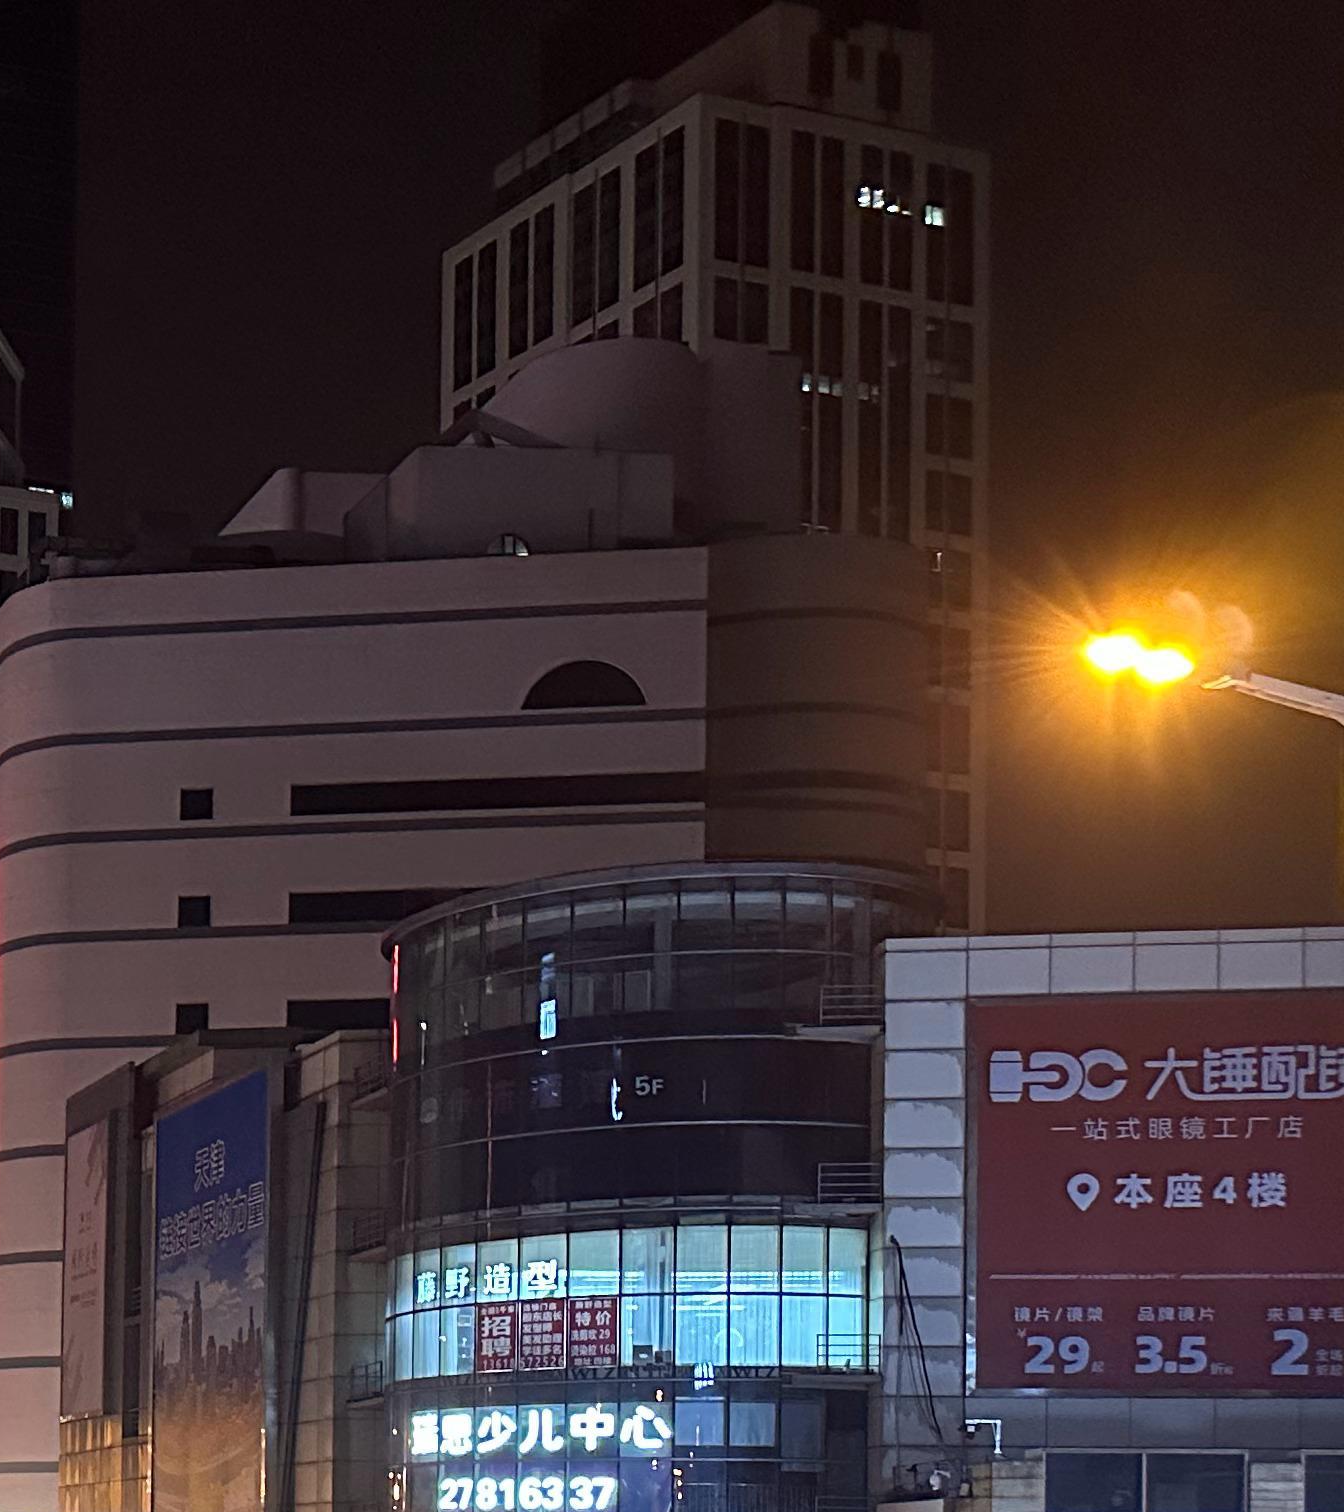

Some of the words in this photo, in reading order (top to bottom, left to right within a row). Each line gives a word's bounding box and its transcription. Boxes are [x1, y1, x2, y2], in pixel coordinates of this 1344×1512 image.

[635, 1076, 664, 1096] 5F
[1051, 1116, 1303, 1140] 一站式眼镜工厂店
[194, 1139, 224, 1191] 天津
[1114, 1173, 1287, 1208] 本座4楼
[481, 1316, 512, 1357] 招聘
[574, 1311, 611, 1327] 特价
[598, 1328, 611, 1339] 29
[1024, 1336, 1090, 1374] 29
[1135, 1335, 1208, 1374] 3.5
[1271, 1329, 1309, 1376] 2
[439, 1476, 616, 1511] 27816337
